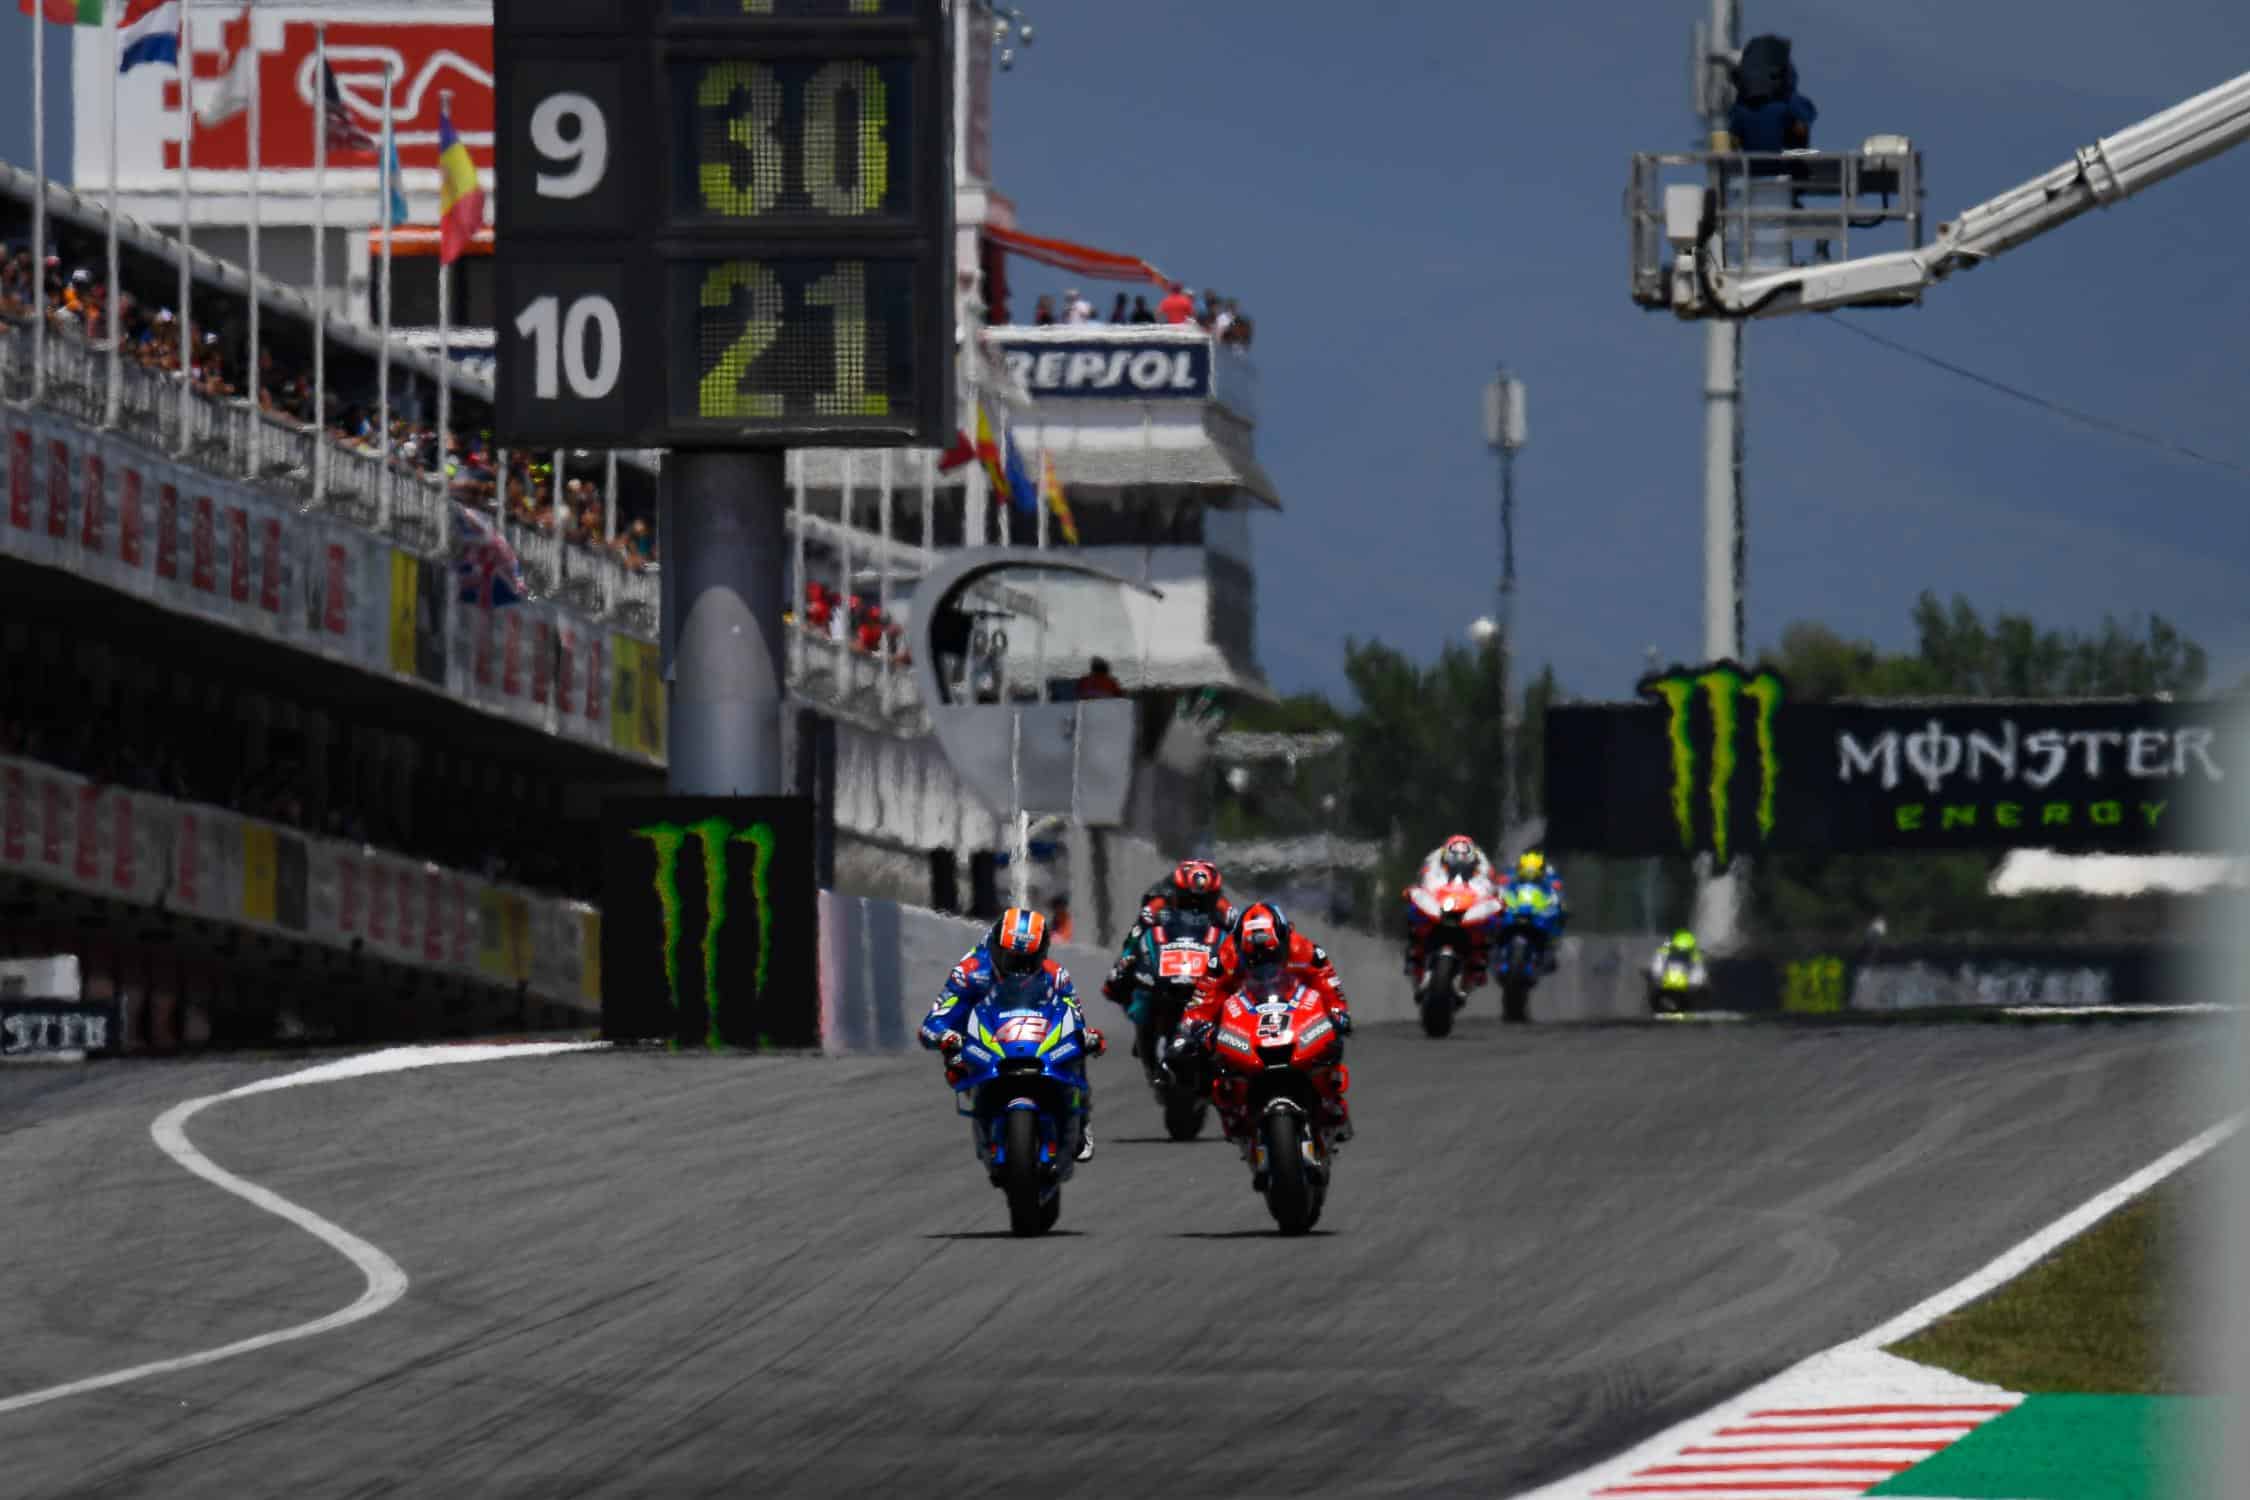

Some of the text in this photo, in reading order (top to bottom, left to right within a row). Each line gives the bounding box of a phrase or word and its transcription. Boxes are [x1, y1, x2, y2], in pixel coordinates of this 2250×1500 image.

[530, 59, 888, 216] 9 30
[515, 261, 889, 417] 10 21
[1004, 350, 1197, 389] REPSOL
[1838, 719, 2222, 792] MONSTER
[1896, 802, 2166, 829] ENERGY
[992, 1016, 1051, 1042] 42
